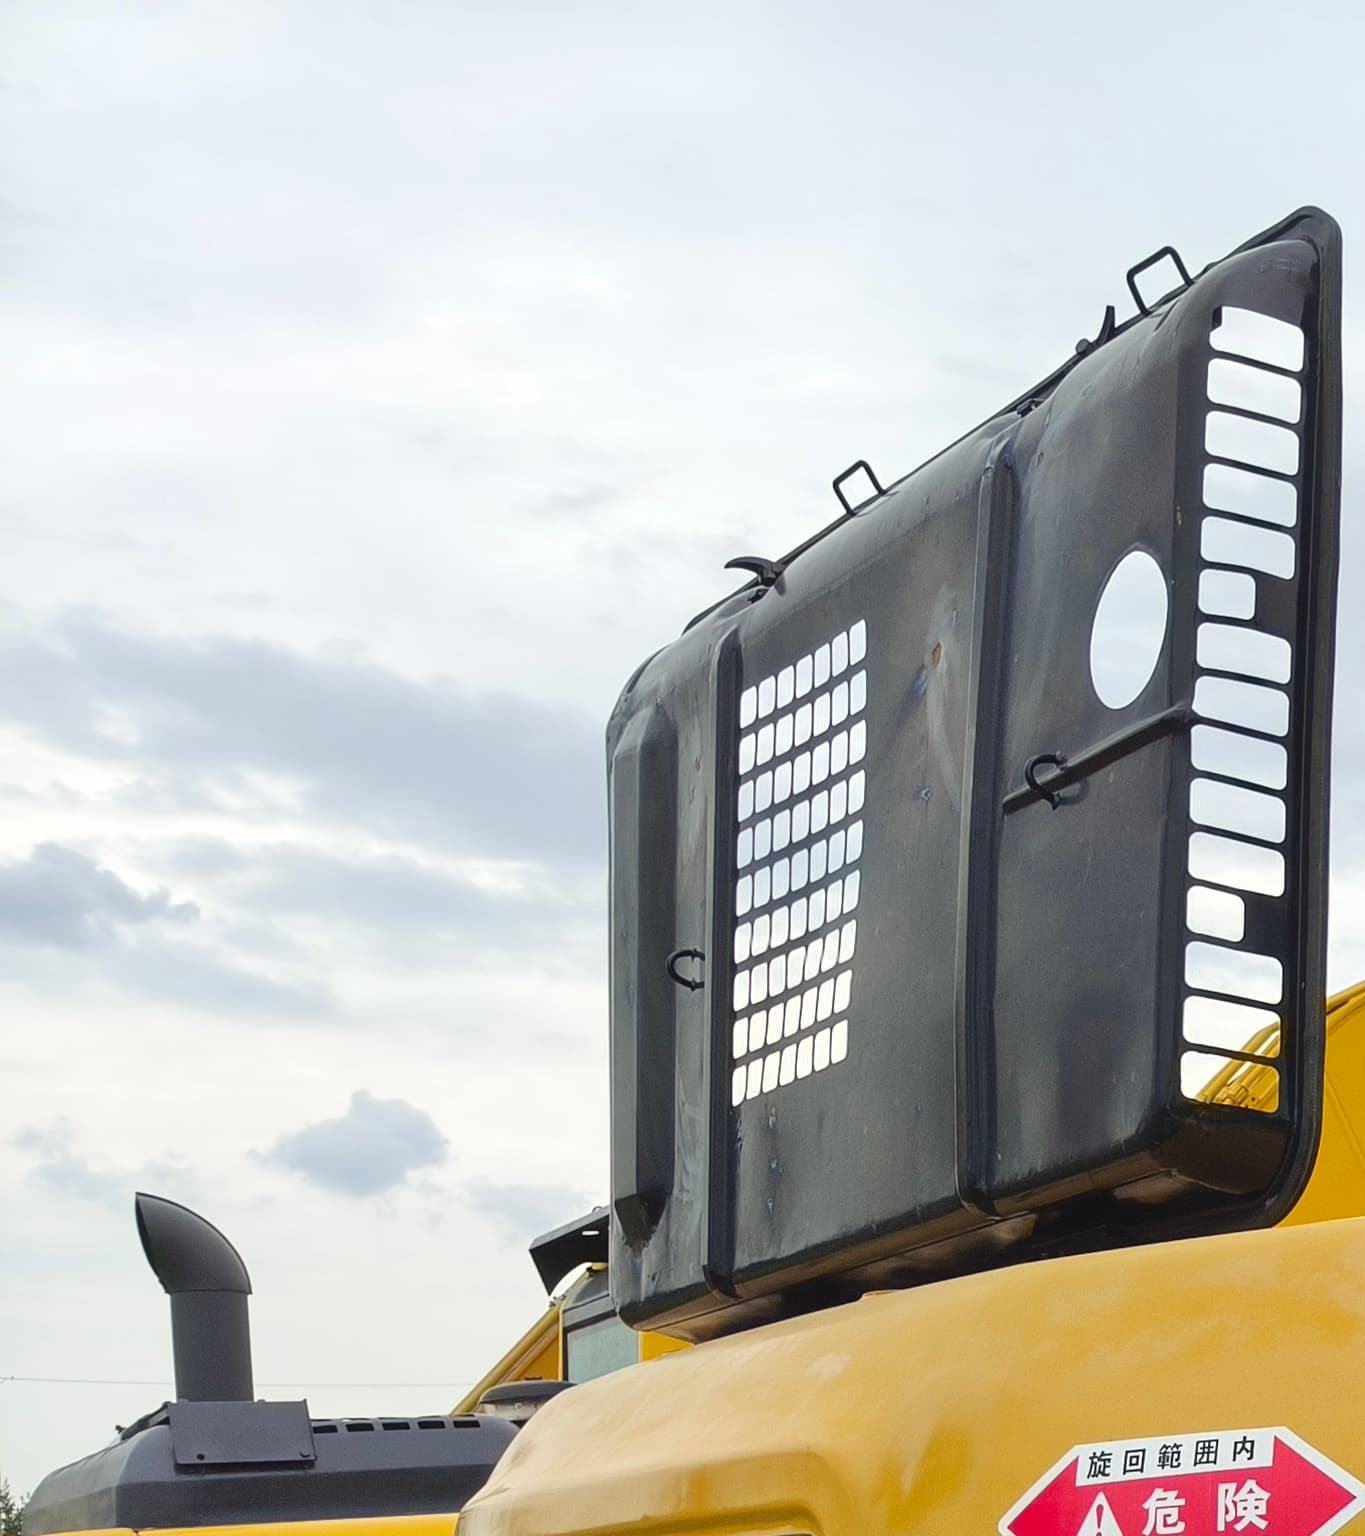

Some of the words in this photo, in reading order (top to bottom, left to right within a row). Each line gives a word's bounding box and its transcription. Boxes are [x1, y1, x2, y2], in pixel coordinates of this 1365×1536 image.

[1086, 1435, 1256, 1480] 旋回範囲内
[1141, 1478, 1272, 1536] 危険
